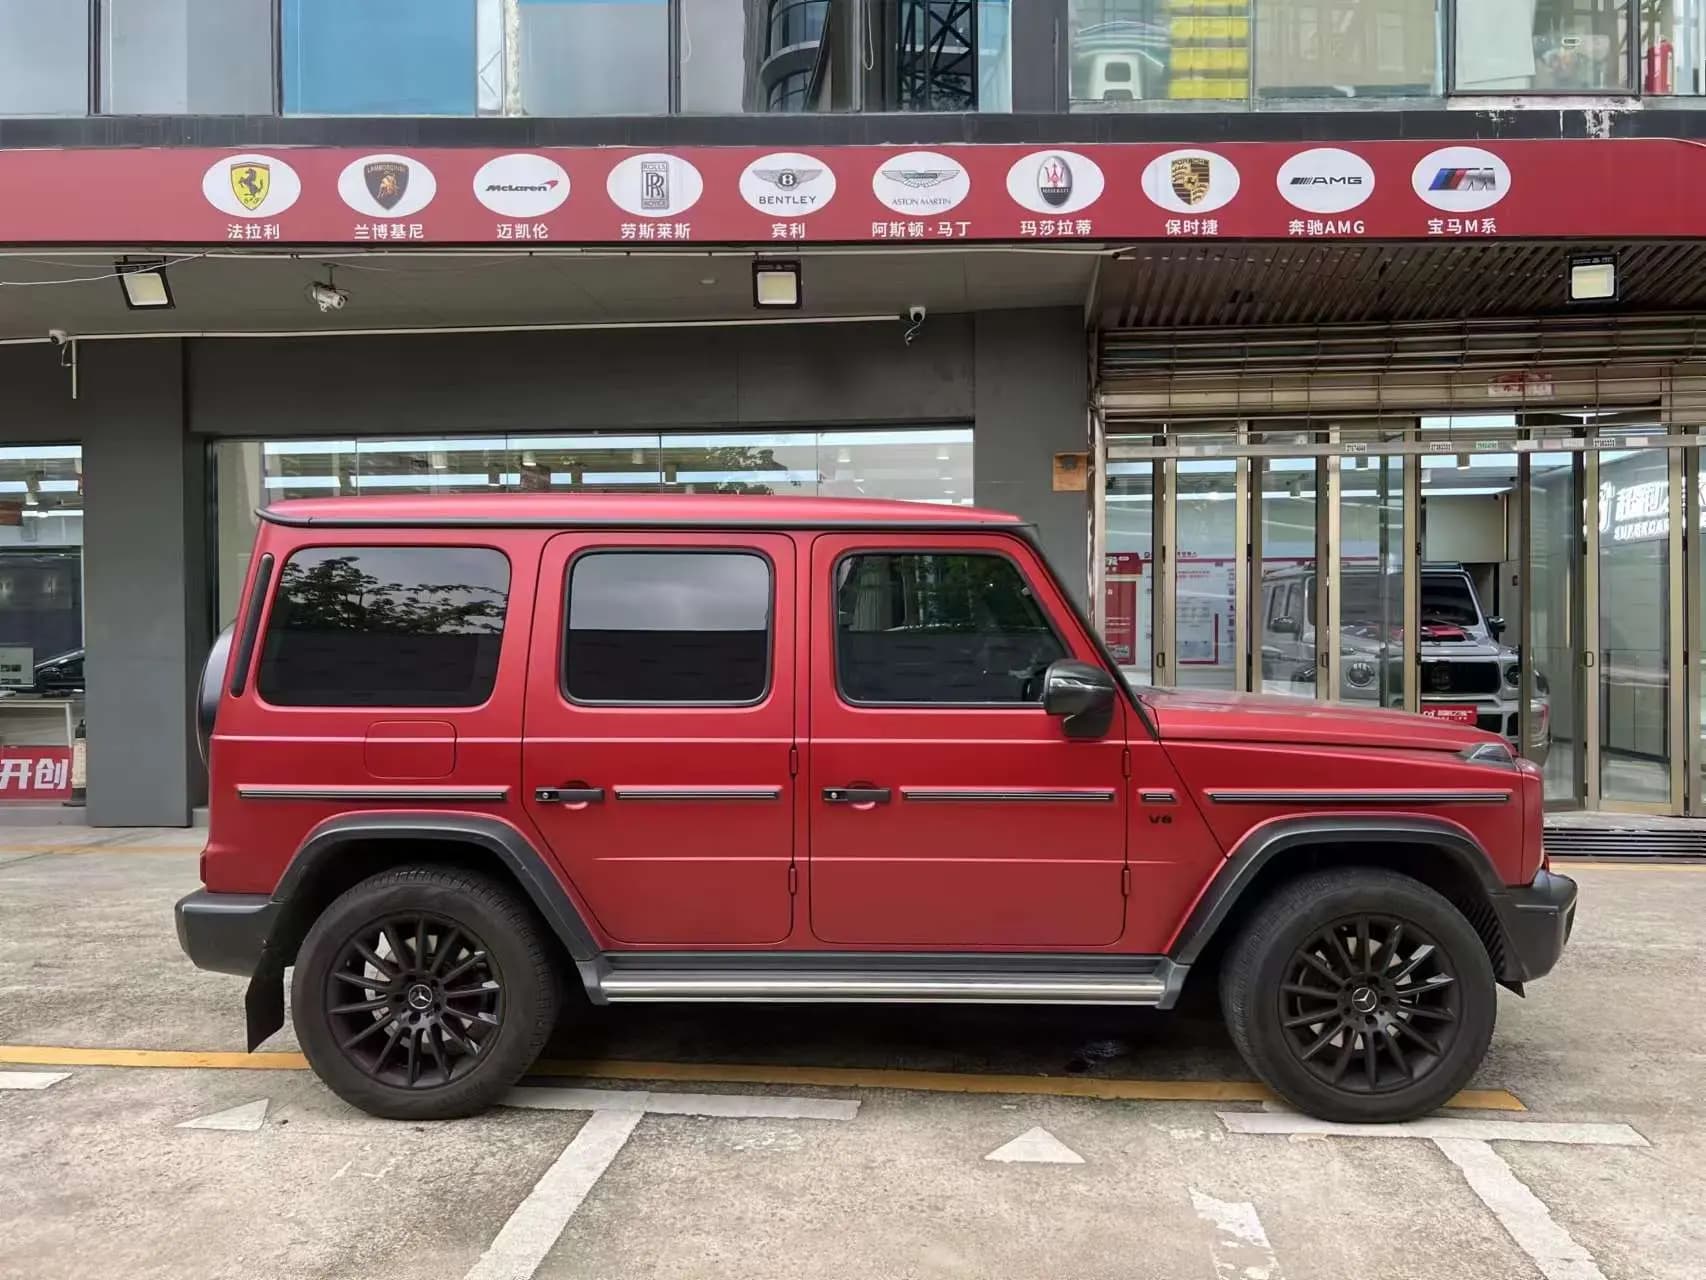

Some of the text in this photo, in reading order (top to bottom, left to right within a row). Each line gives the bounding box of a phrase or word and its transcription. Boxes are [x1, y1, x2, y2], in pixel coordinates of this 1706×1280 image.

[485, 184, 547, 192] McLaren
[781, 174, 794, 186] B
[1312, 175, 1363, 185] AMG
[758, 195, 817, 205] BENTLEY
[891, 197, 951, 206] ASTON MARTIN
[227, 223, 280, 240] 法拉利
[353, 223, 425, 240] 兰博基尼
[496, 223, 549, 239] 迈凯伦
[620, 223, 692, 239] 劳斯莱斯
[771, 222, 806, 239] 宾利
[1019, 219, 1092, 237] 玛莎拉蒂
[1164, 219, 1219, 236] 保时捷
[1288, 219, 1365, 236] 奔驰AMG
[1427, 217, 1497, 235] 宝马M系
